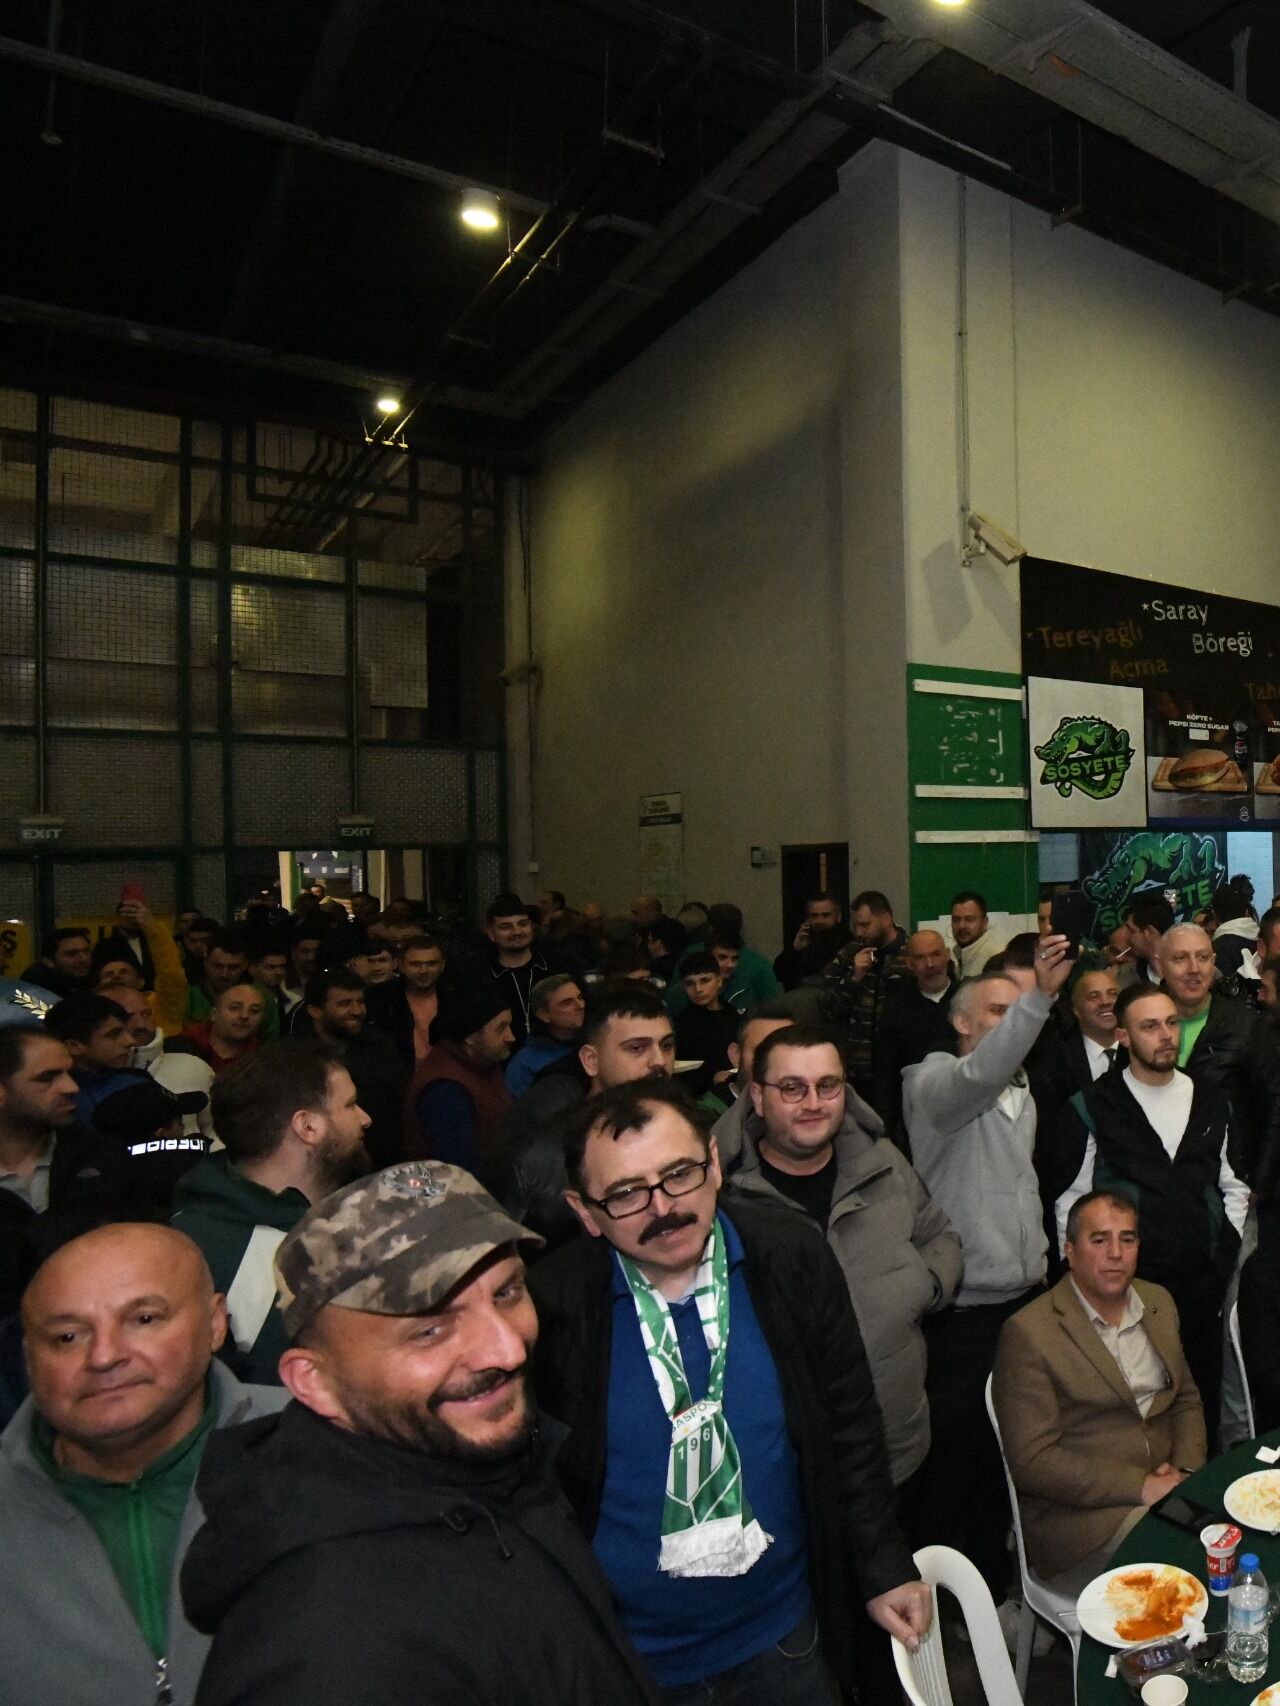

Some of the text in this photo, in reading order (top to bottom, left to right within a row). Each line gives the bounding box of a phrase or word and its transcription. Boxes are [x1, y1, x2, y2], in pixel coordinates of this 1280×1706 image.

[1151, 600, 1209, 626] Saray
[1192, 631, 1254, 657] Böreği
[1045, 754, 1127, 781] SOSYETE
[22, 828, 62, 840] EXIT
[341, 827, 374, 837] EXIT
